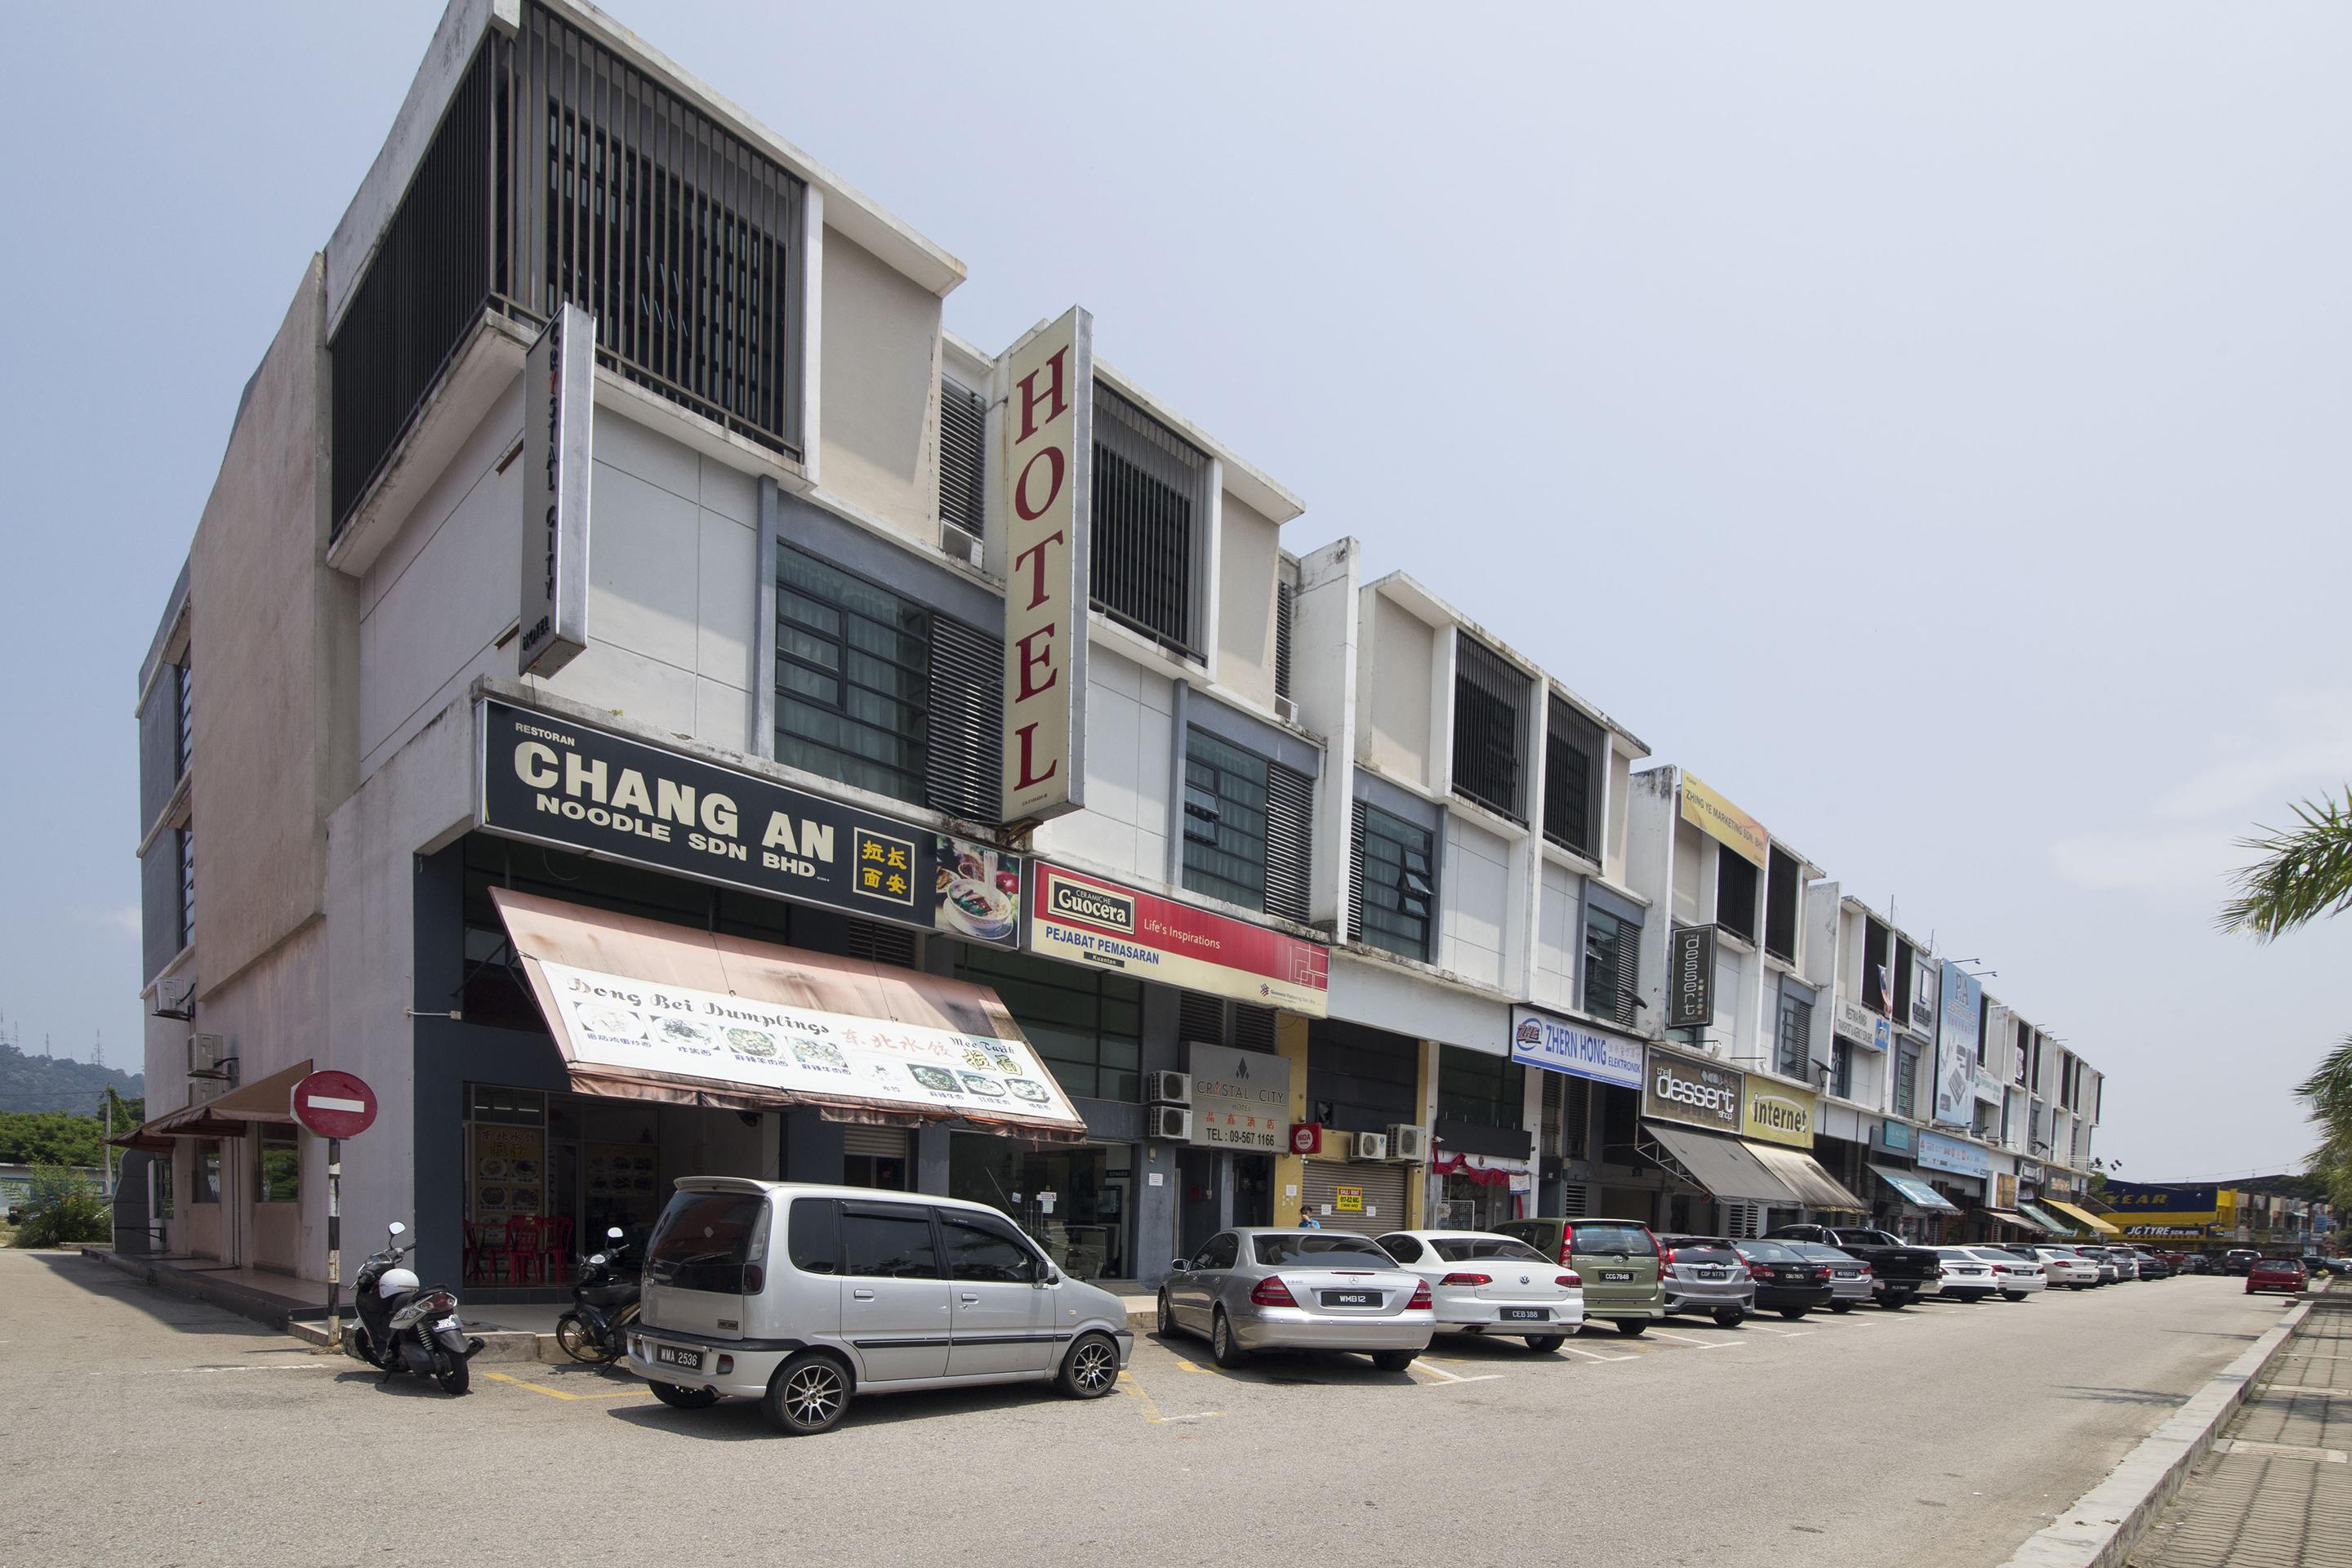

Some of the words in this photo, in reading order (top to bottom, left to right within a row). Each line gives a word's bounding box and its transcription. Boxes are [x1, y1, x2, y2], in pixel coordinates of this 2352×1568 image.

[547, 322, 559, 492] CRYSTAL
[544, 505, 556, 602] CITY
[1014, 343, 1069, 792] HOTEL
[522, 615, 550, 652] HOTEL
[515, 722, 575, 746] RESTORAN
[514, 741, 739, 838] CHANG
[761, 810, 834, 863] AN
[537, 794, 671, 842] NOODLE
[688, 832, 746, 862] SDN
[763, 851, 816, 878] BHD
[1058, 889, 1126, 924] Guocera
[1076, 890, 1111, 905] CERAMICHE
[1046, 926, 1095, 949] PEJABAT
[1098, 939, 1160, 964] PEMASARAN
[1144, 918, 1168, 935] Life's
[1169, 926, 1221, 950] Inspirations
[1092, 954, 1116, 965] Kuantan
[1683, 934, 1699, 1015] dessert
[650, 992, 694, 1012] Bei
[1517, 1024, 1540, 1041] ZHE
[1545, 1024, 1578, 1059] ZHERN
[1580, 1034, 1607, 1066] HONG
[1608, 1056, 1642, 1074] ELEKTRONIK
[1656, 1067, 1669, 1077] the
[1196, 1081, 1249, 1099] CRYSTAL
[1259, 1090, 1284, 1104] CITY
[1656, 1068, 1735, 1113] dessert
[1717, 1110, 1732, 1121] shop
[1753, 1092, 1807, 1134] internet
[1230, 1130, 1255, 1144] 09-567
[1258, 1133, 1274, 1147] 1166
[2144, 1227, 2171, 1235] TYRE
[662, 1349, 675, 1362] WMA
[678, 1352, 697, 1366] 2536
